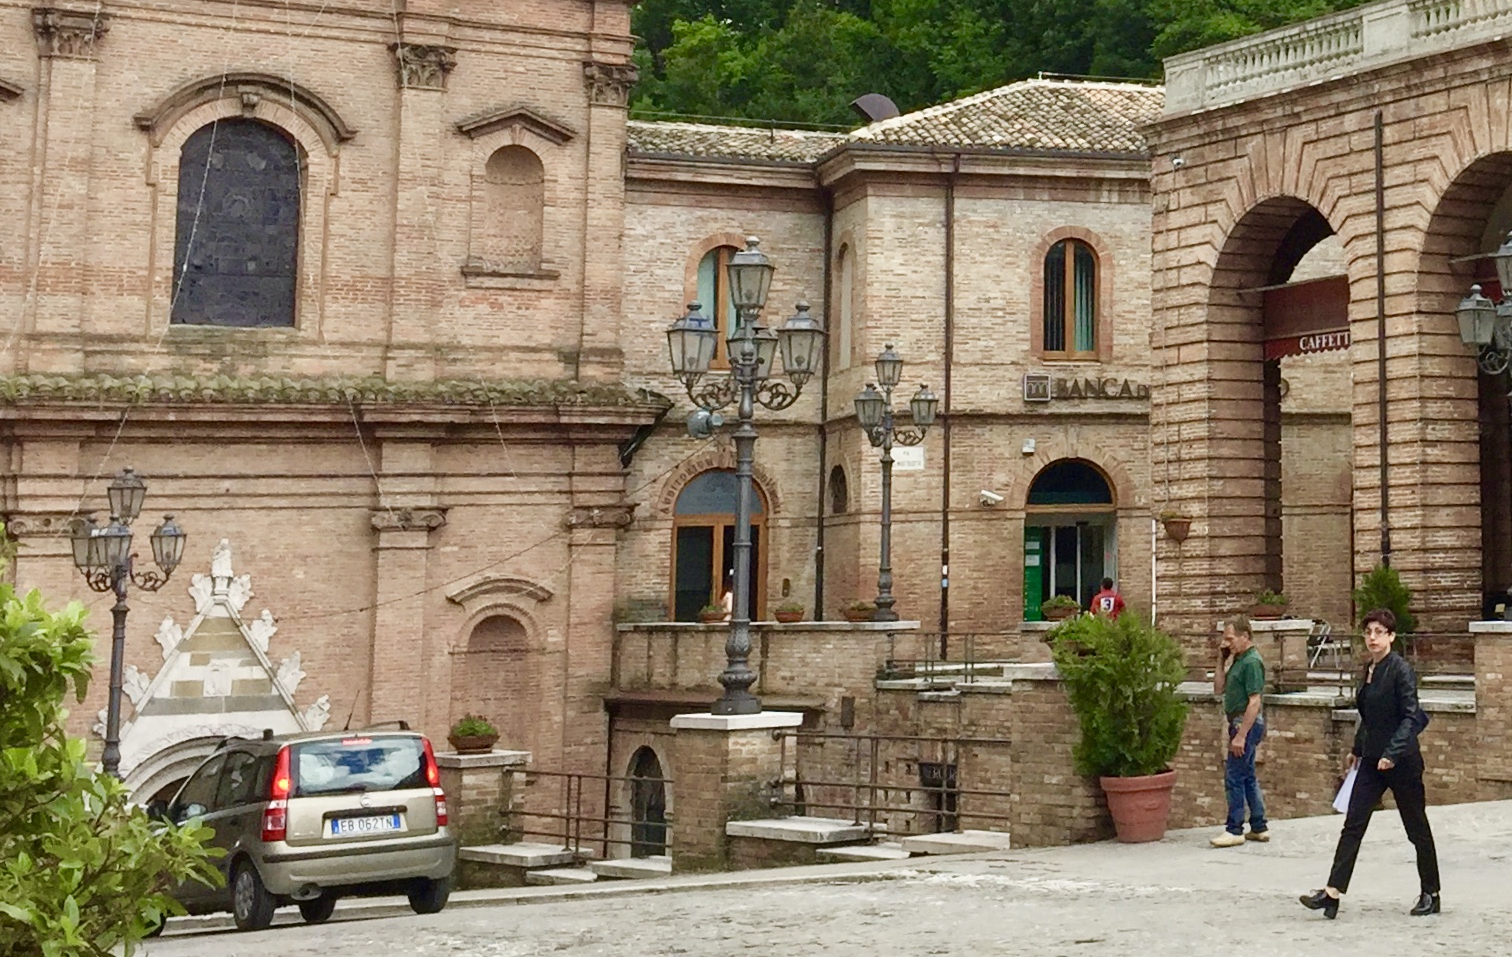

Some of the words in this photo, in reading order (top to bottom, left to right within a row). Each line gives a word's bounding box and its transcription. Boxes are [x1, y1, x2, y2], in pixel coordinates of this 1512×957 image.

[1299, 331, 1350, 351] CAFFETT
[1056, 377, 1134, 399] BANCA
[1103, 598, 1112, 611] 3
[340, 819, 355, 832] EB
[357, 816, 393, 830] 062TN
